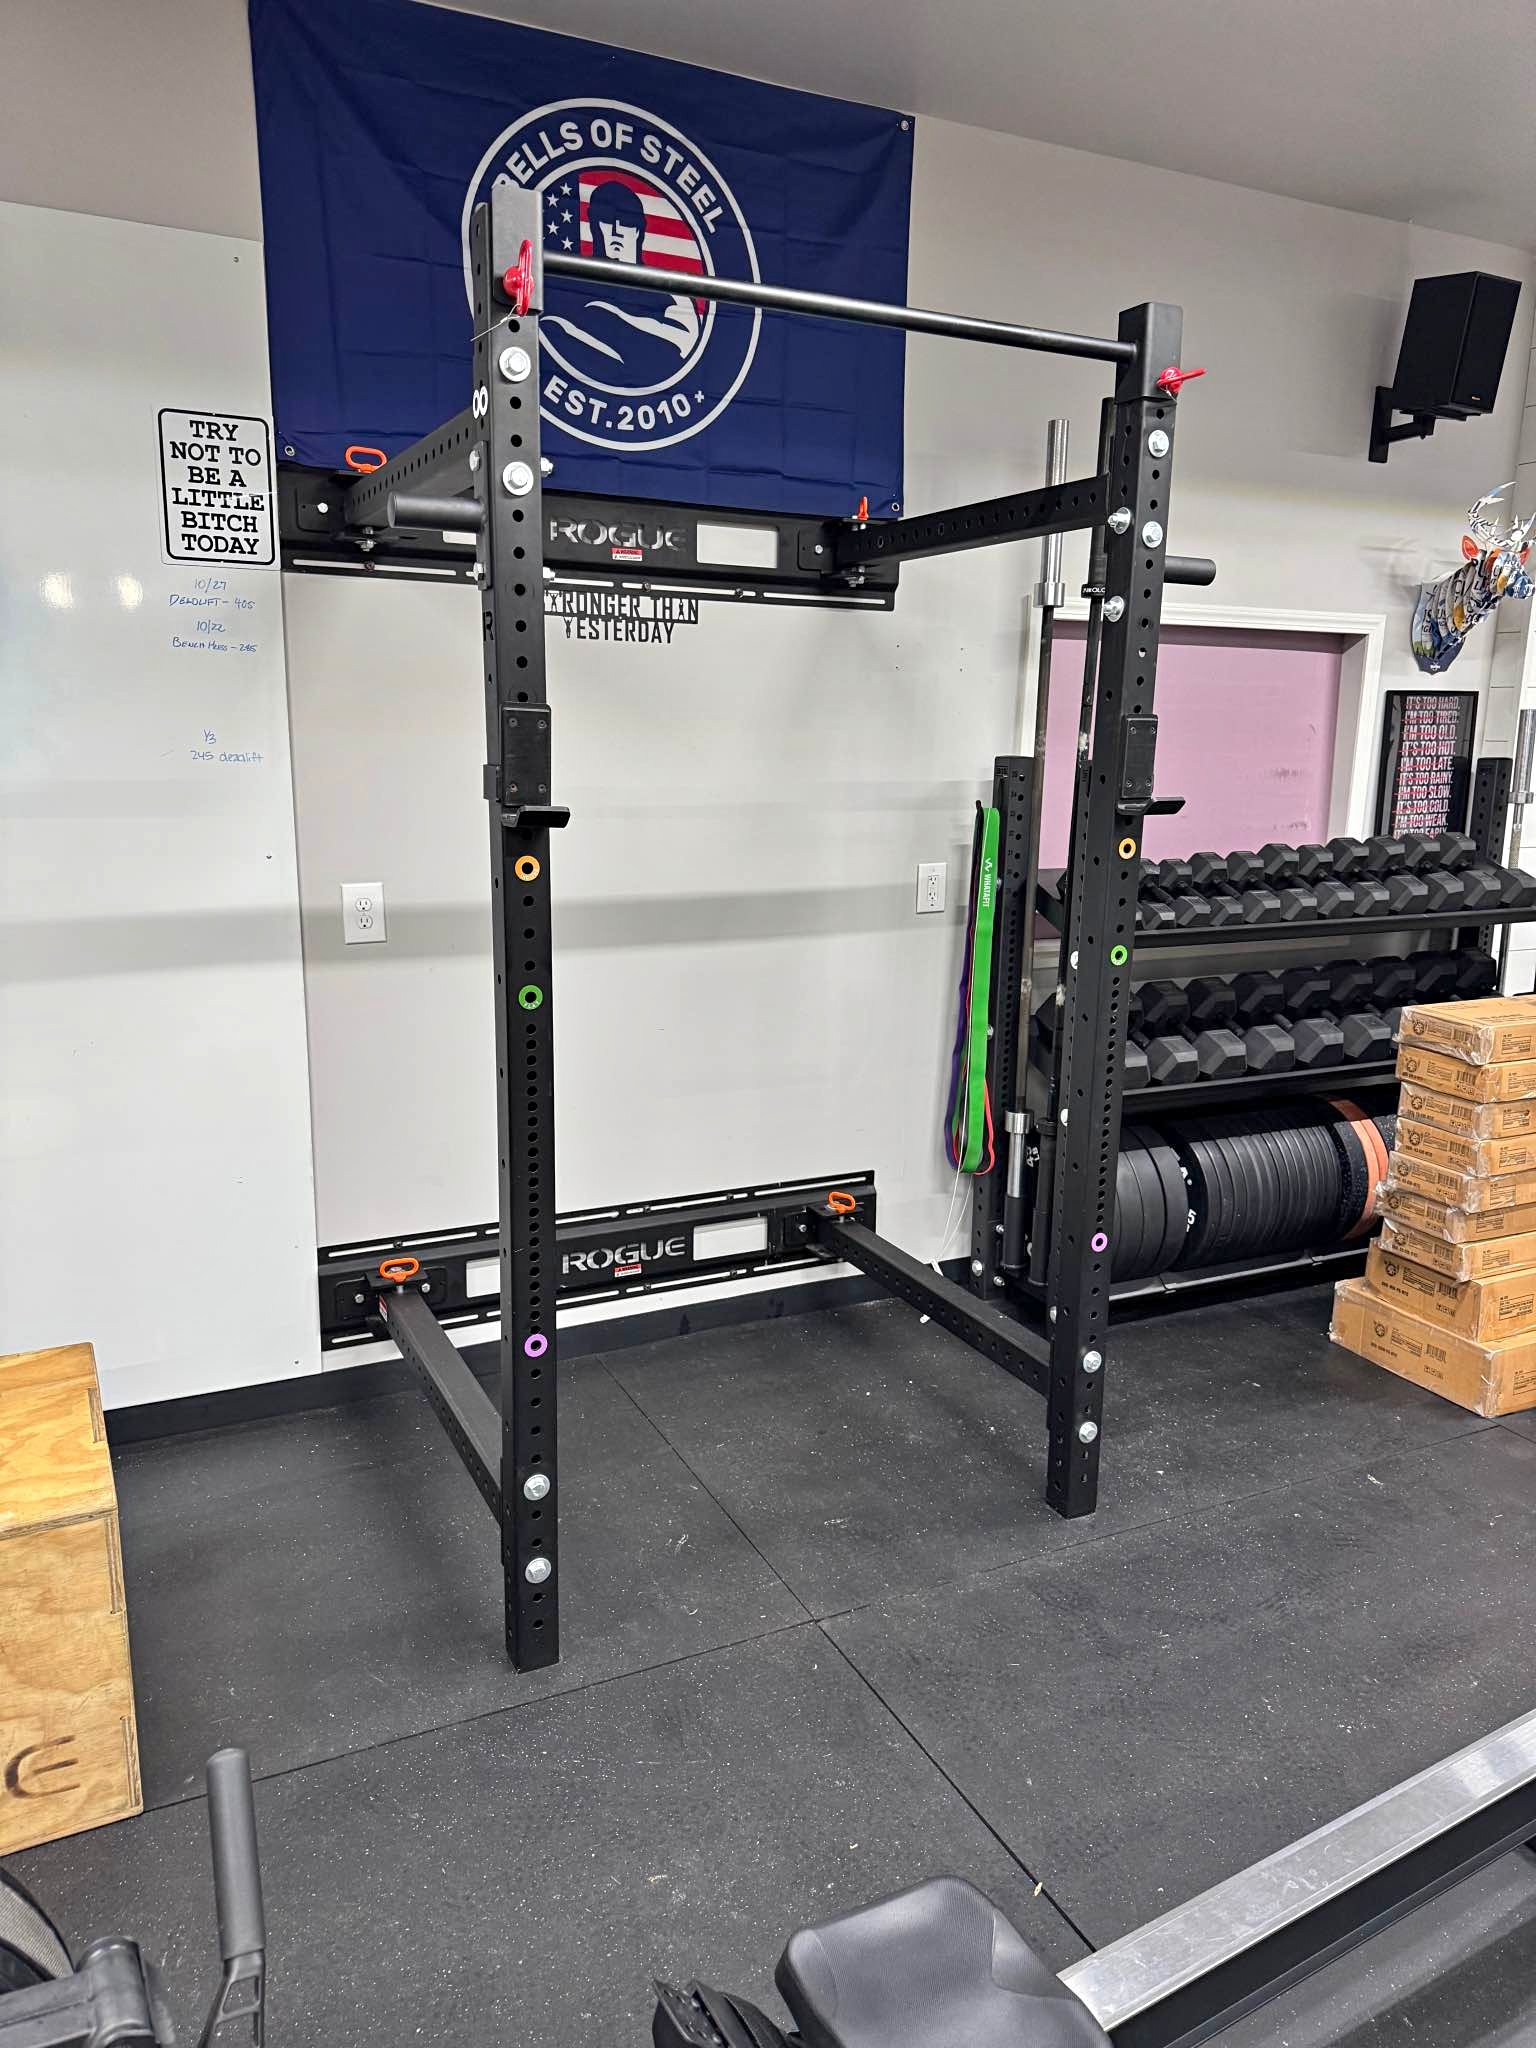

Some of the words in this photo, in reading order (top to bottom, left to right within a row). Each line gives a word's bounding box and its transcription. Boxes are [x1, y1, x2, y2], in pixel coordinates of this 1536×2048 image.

[590, 119, 633, 150] OF
[640, 134, 725, 234] STEEL
[189, 420, 239, 441] TRY
[169, 441, 220, 463] NOT
[229, 447, 261, 466] TO
[187, 465, 221, 485] BE
[229, 469, 247, 487] A
[172, 487, 265, 511] LITTLE
[181, 511, 258, 533] BITCH
[550, 517, 687, 551] ROGUE
[181, 533, 259, 555] TODAY
[194, 578, 227, 593] 10/27
[234, 598, 256, 609] 405
[653, 597, 699, 623] THAN
[196, 620, 226, 634] 10/22
[563, 616, 675, 644] YESTERDAY
[1406, 696, 1421, 710] IT'S
[1422, 696, 1437, 710] TOO
[1438, 696, 1460, 710] HARD.
[1404, 711, 1417, 724] I'M
[1418, 711, 1434, 724] TOO
[1435, 711, 1459, 724] TIRED.
[1403, 725, 1418, 740] I'M
[1420, 725, 1437, 740] TOO
[1438, 725, 1457, 740] OLD.
[1402, 741, 1419, 756] IT'S
[1420, 741, 1437, 756] TOO
[1438, 741, 1456, 755] HOT.
[190, 750, 215, 761] 245
[219, 751, 265, 763] deadlift
[1400, 757, 1414, 771] I'M
[1416, 757, 1431, 771] TOO
[1433, 757, 1454, 770] LATE.
[1399, 772, 1414, 786] IT'S
[1415, 772, 1429, 785] TOO
[1430, 771, 1454, 784] RAINY.
[1398, 786, 1411, 800] I'M
[1412, 786, 1428, 799] TOO
[1428, 785, 1451, 799] SLOW.
[1396, 800, 1412, 814] IT'S
[1413, 800, 1428, 814] TOO
[1429, 799, 1450, 813] COLD.
[1394, 815, 1408, 828] I'M
[1409, 814, 1424, 827] TOO
[1425, 813, 1449, 827] WEAK.
[562, 1236, 686, 1275] ROGUE
